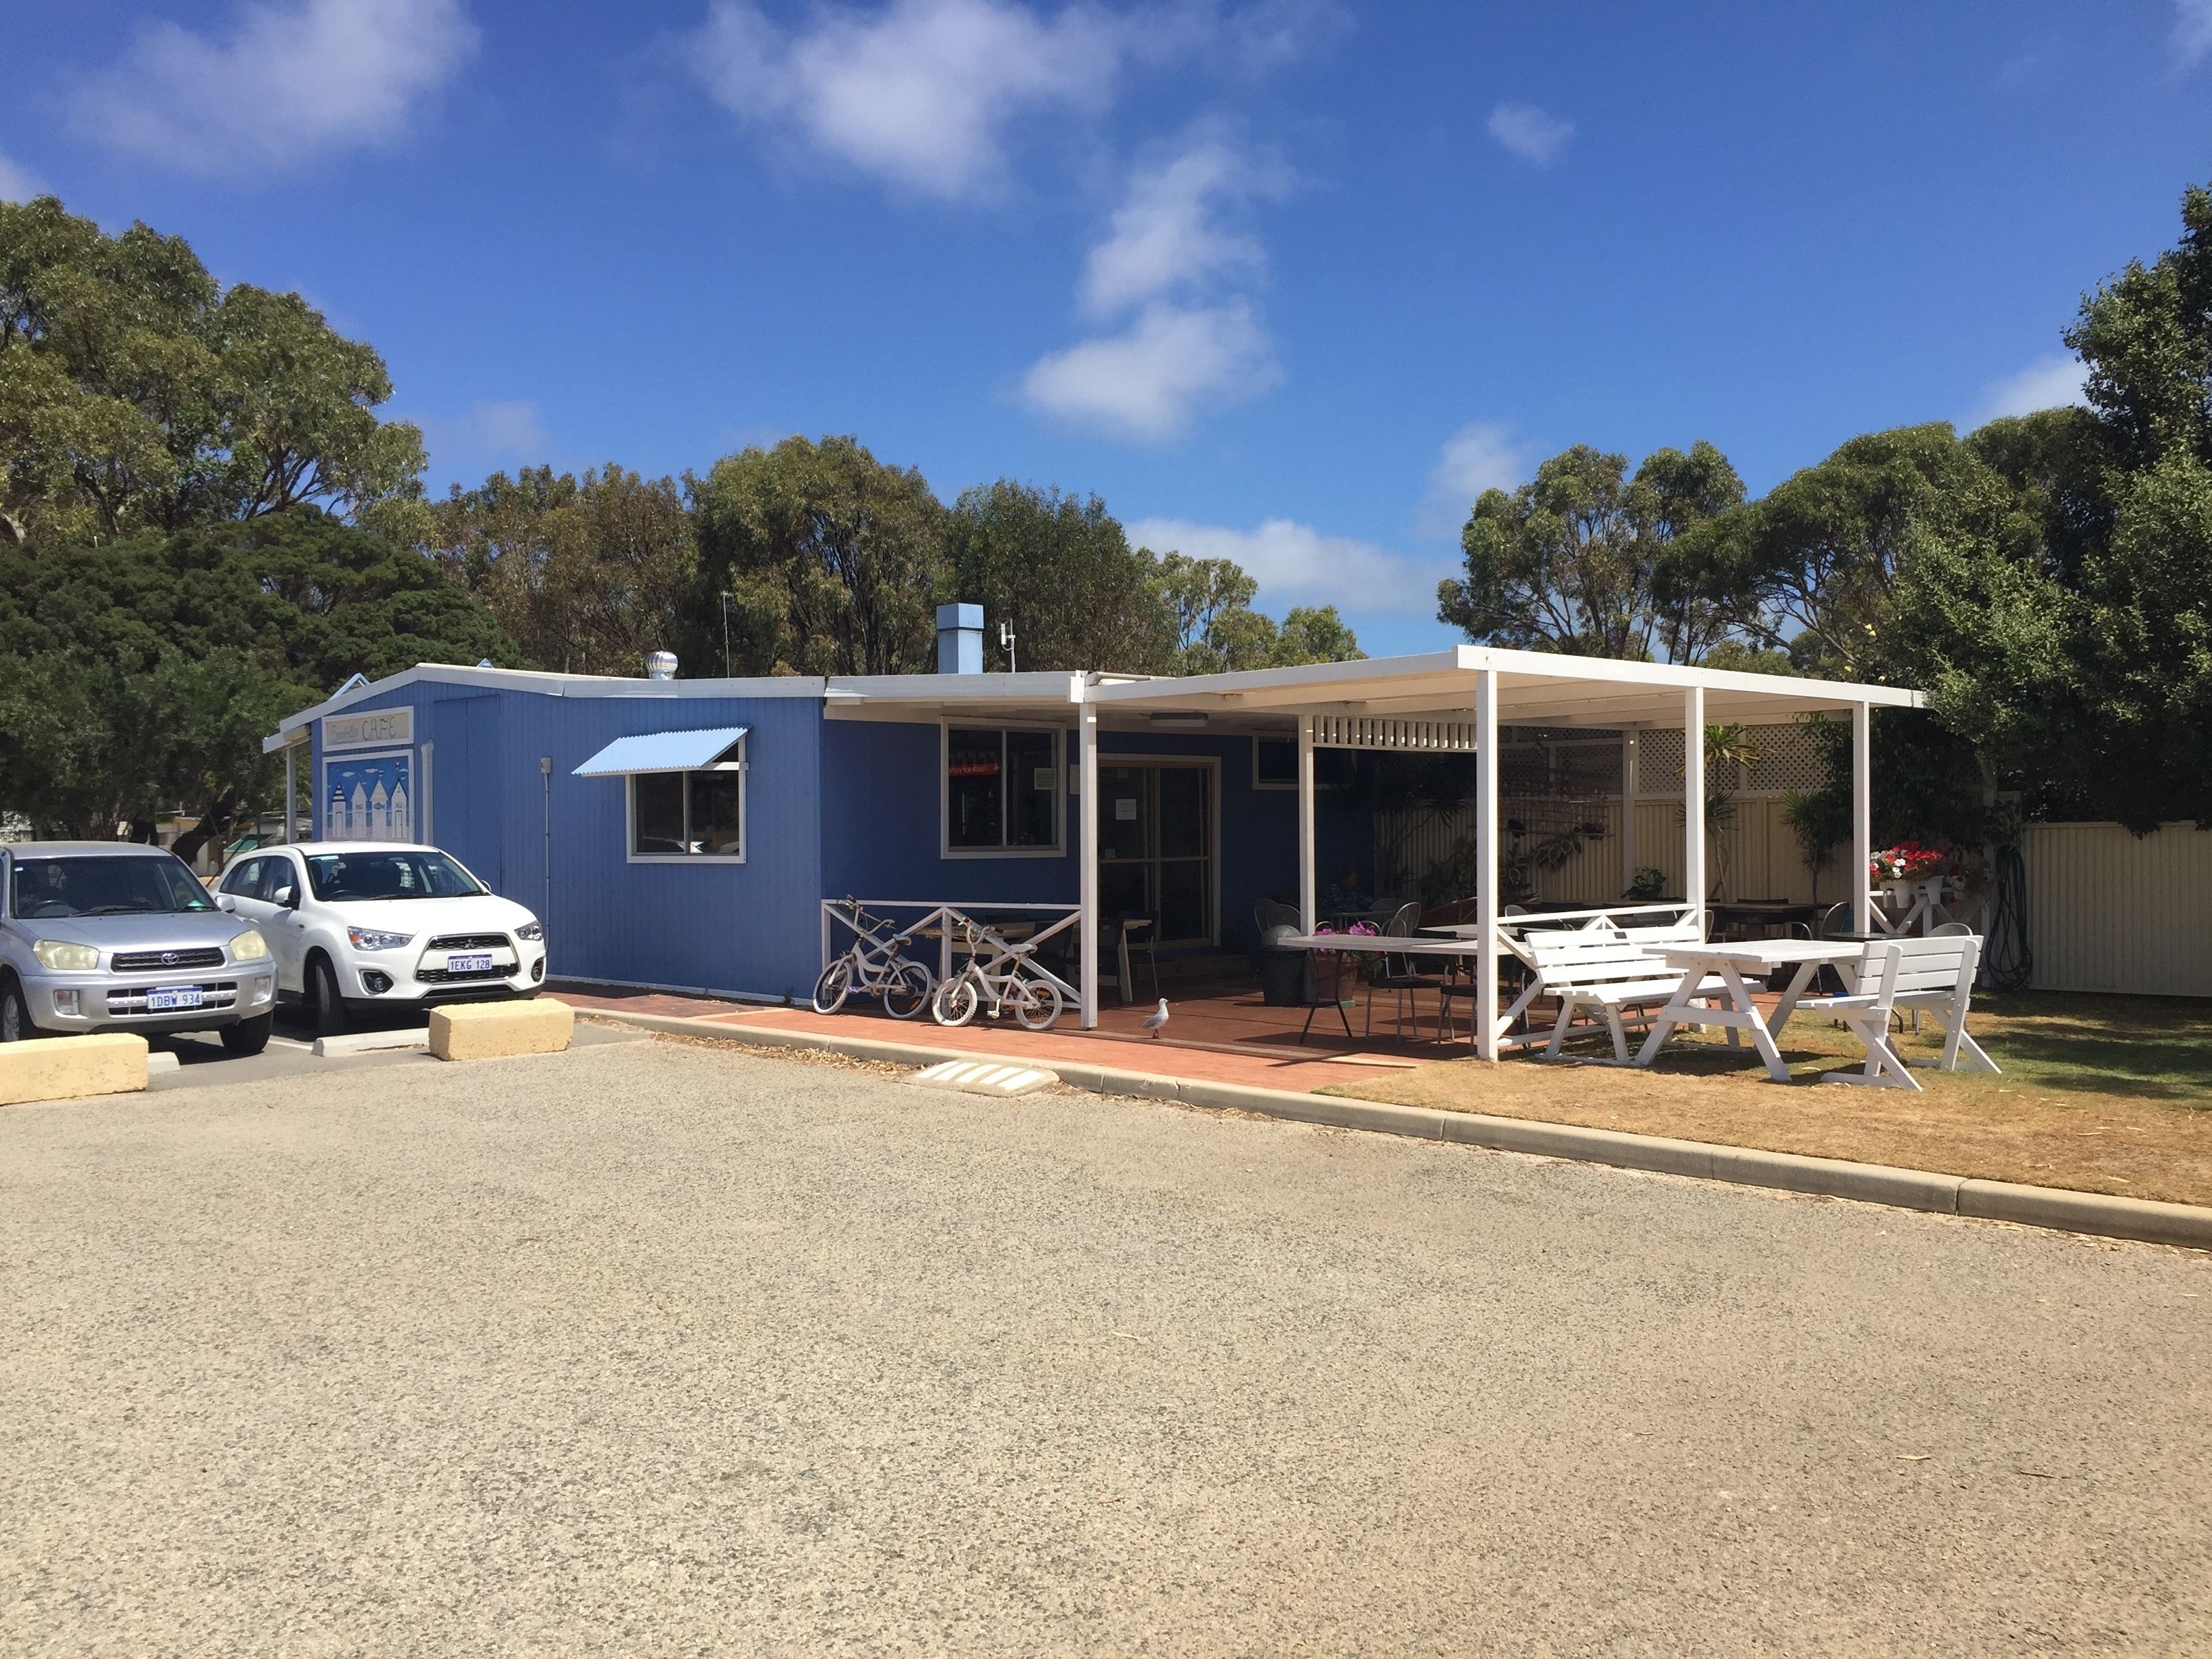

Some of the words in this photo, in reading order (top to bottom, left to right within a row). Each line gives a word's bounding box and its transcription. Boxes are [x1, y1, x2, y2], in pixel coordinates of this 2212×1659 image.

[451, 960, 472, 970] 1EKG
[476, 959, 490, 969] 128
[151, 996, 178, 1007] 1DBW
[182, 994, 200, 1005] 934
